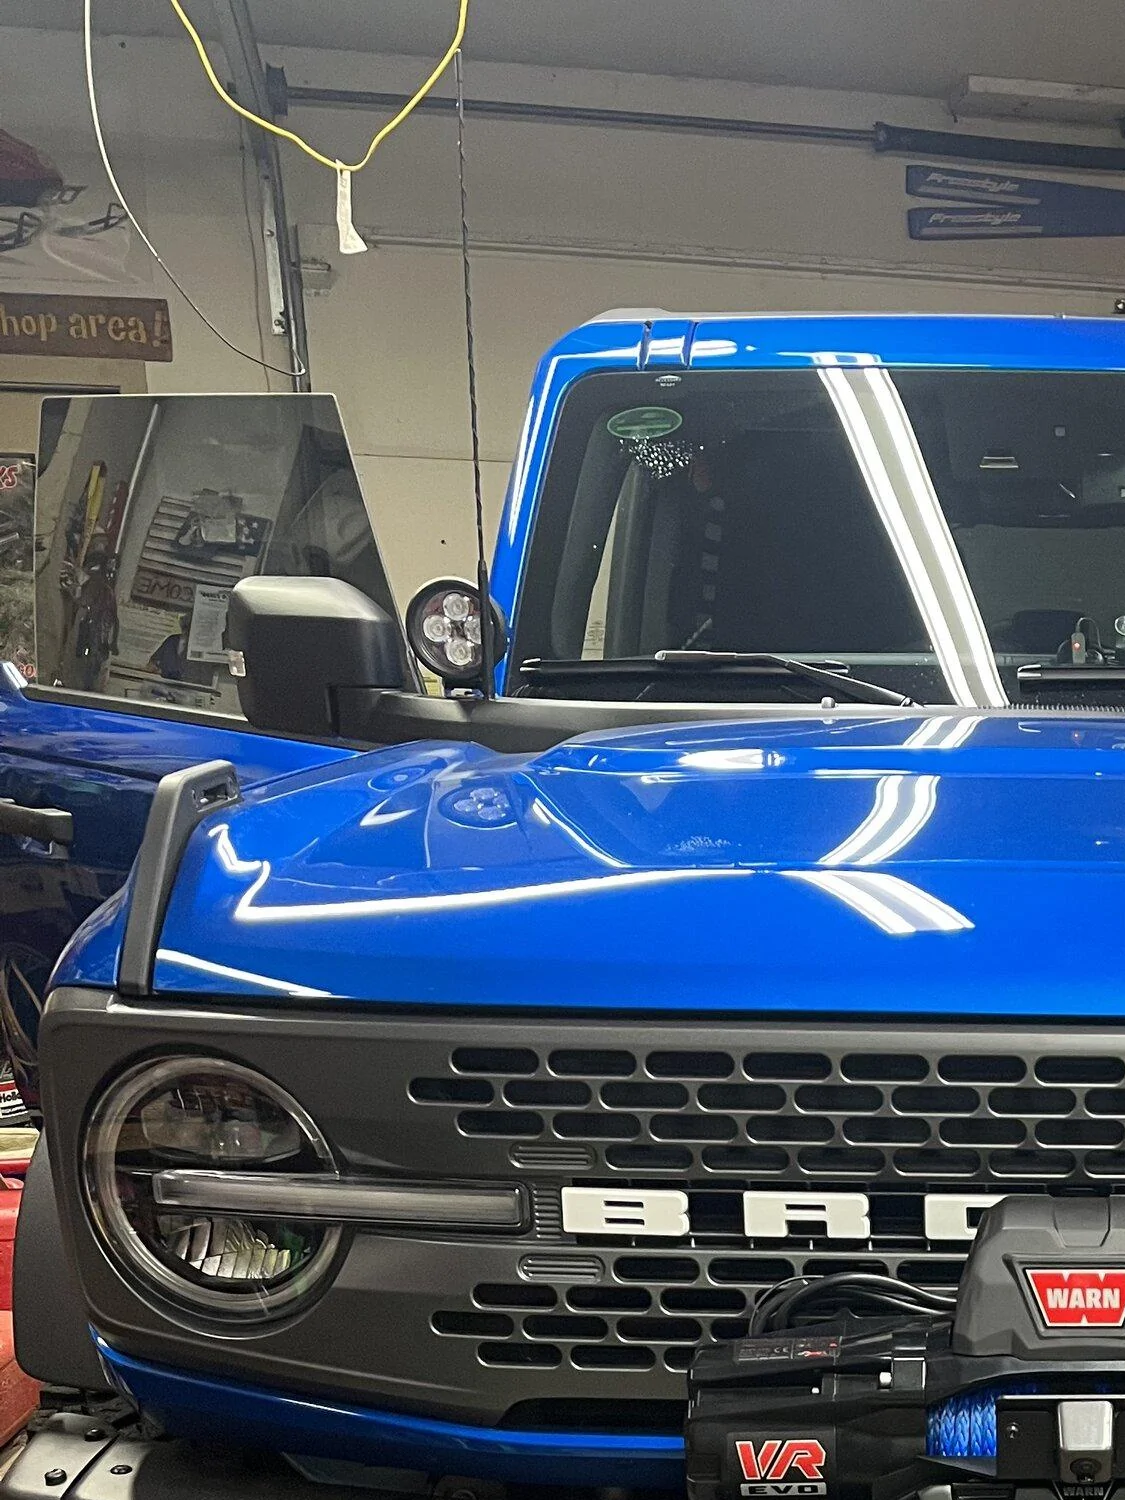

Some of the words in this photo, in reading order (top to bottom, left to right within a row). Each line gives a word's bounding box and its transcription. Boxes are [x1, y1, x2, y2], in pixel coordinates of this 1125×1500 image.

[68, 310, 162, 348] area!
[1046, 1287, 1121, 1309] WARN
[735, 1439, 827, 1480] VR
[748, 1484, 819, 1495] EVO
[1063, 1485, 1105, 1497] WARN
